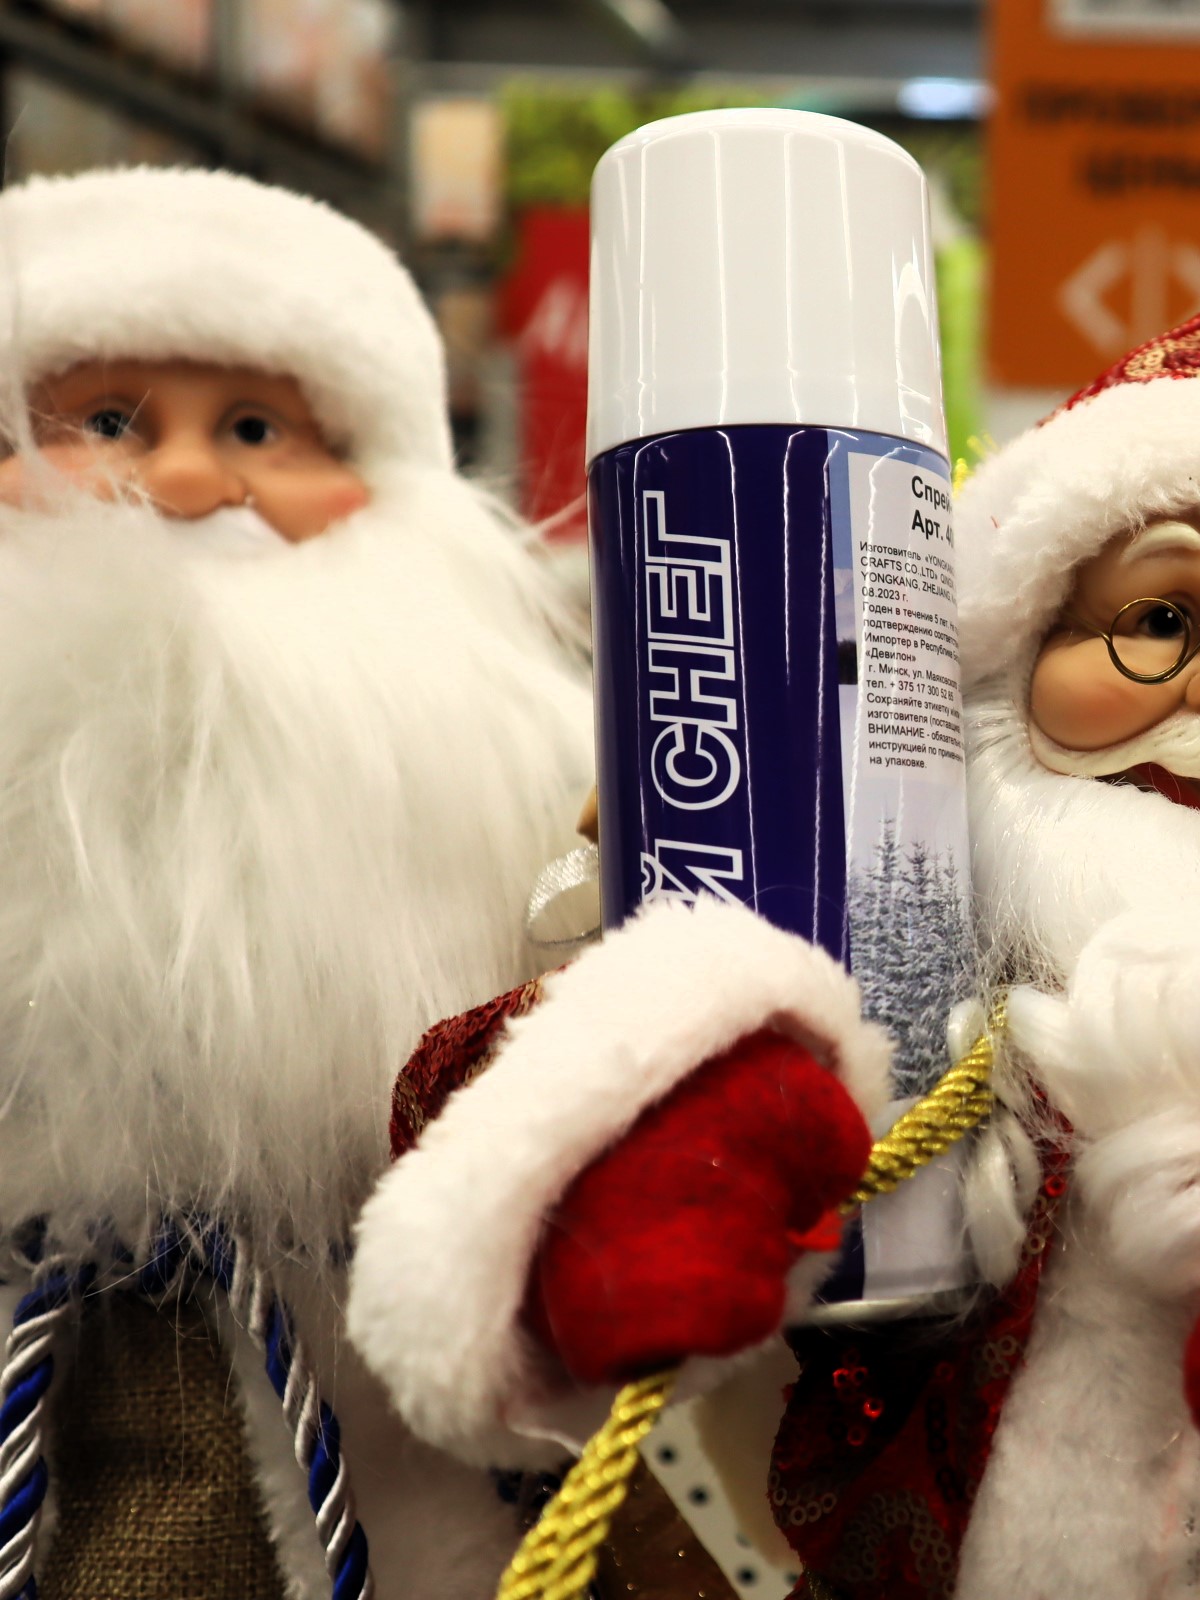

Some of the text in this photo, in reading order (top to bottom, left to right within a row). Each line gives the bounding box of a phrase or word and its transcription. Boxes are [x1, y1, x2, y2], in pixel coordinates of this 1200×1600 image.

[912, 509, 944, 541] Арт.
[860, 541, 921, 561] Изготовитель
[861, 556, 902, 571] CRAFTS
[861, 571, 921, 591] YONGKANG,
[862, 586, 900, 601] 08.2023
[862, 601, 893, 615] Годен
[896, 607, 901, 615] в
[903, 608, 934, 622] течение
[934, 613, 939, 622] 5
[863, 618, 933, 638] подтверждению
[864, 632, 911, 648] Импортер
[914, 640, 919, 648] в
[643, 490, 741, 811] СНЕГ
[865, 647, 917, 663] «Девилон»
[868, 664, 876, 673] г.
[879, 663, 911, 678] Минск,
[912, 670, 925, 679] ул.
[866, 679, 887, 689] тел.
[898, 681, 914, 692] 375
[917, 684, 926, 693] 17
[928, 685, 939, 697] 300
[941, 688, 947, 698] 52
[866, 693, 923, 708] Сохраняйте
[924, 700, 950, 717] этикетку
[867, 710, 928, 724] изготовителя
[868, 723, 925, 739] ВНИМАНИЕ
[869, 740, 927, 756] инструкцией
[928, 746, 937, 756] по
[869, 756, 927, 769] на упаковке.
